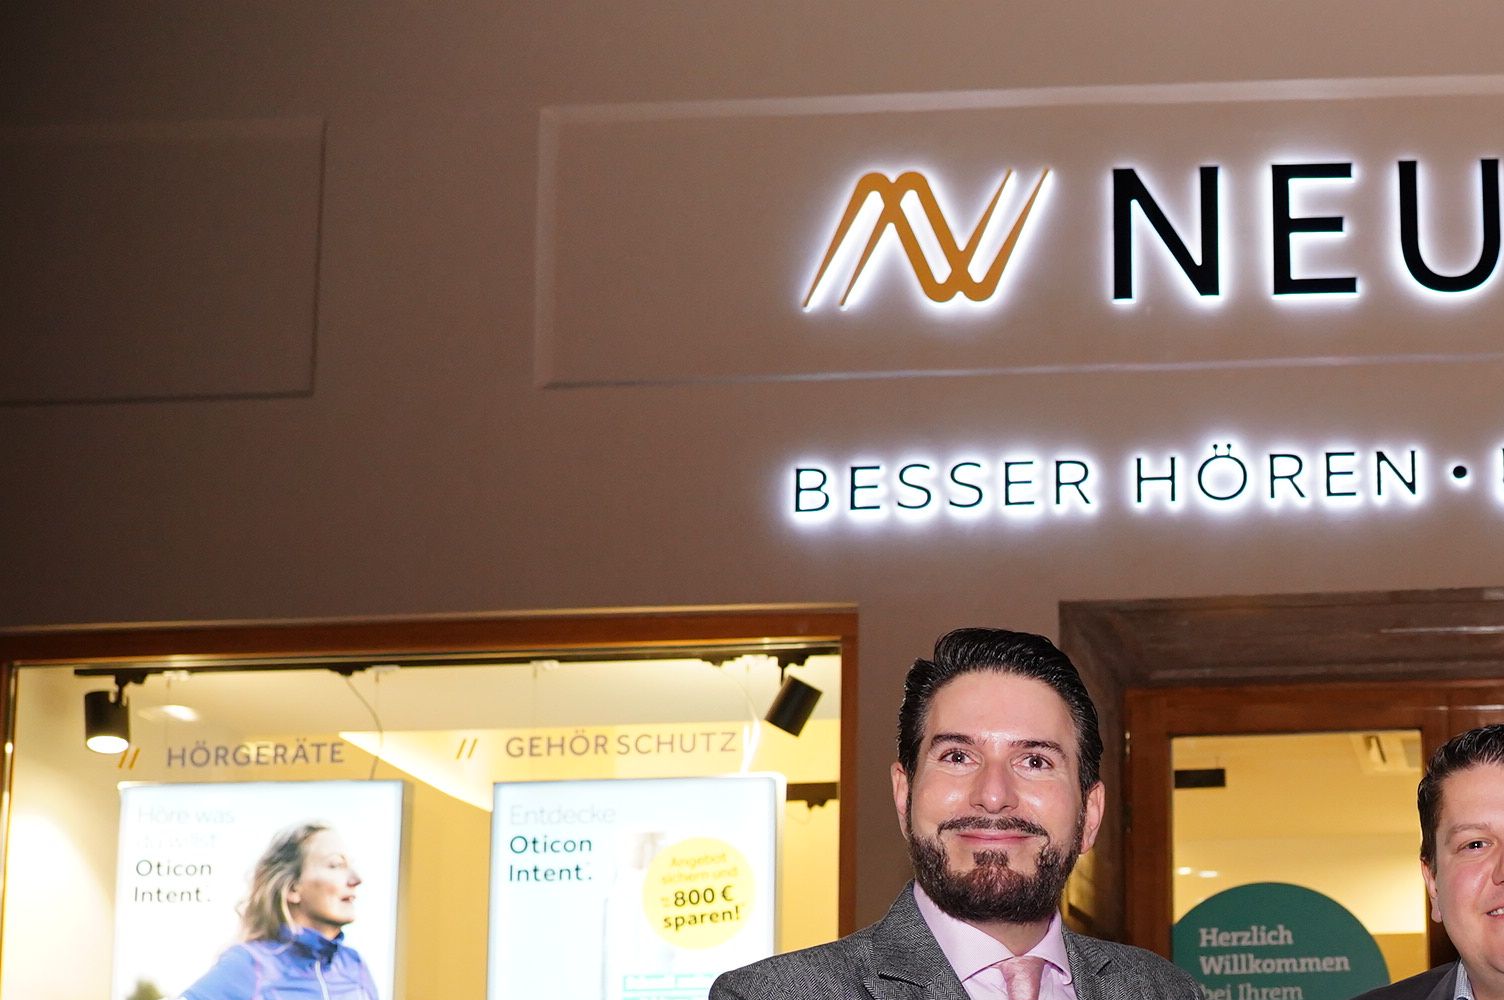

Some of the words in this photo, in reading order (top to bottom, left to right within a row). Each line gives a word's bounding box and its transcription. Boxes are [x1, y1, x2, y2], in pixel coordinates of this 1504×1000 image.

[794, 459, 1091, 513] BESSER
[1136, 443, 1418, 503] HÖREN
[166, 738, 345, 768] HÖRGERÄTE
[511, 804, 616, 826] Entdecke
[510, 835, 592, 854] Oticon
[135, 859, 212, 877] Oticon
[674, 887, 715, 907] 800
[721, 885, 735, 902] €
[1199, 924, 1294, 947] Herzlich
[1199, 953, 1351, 975] Willkommen
